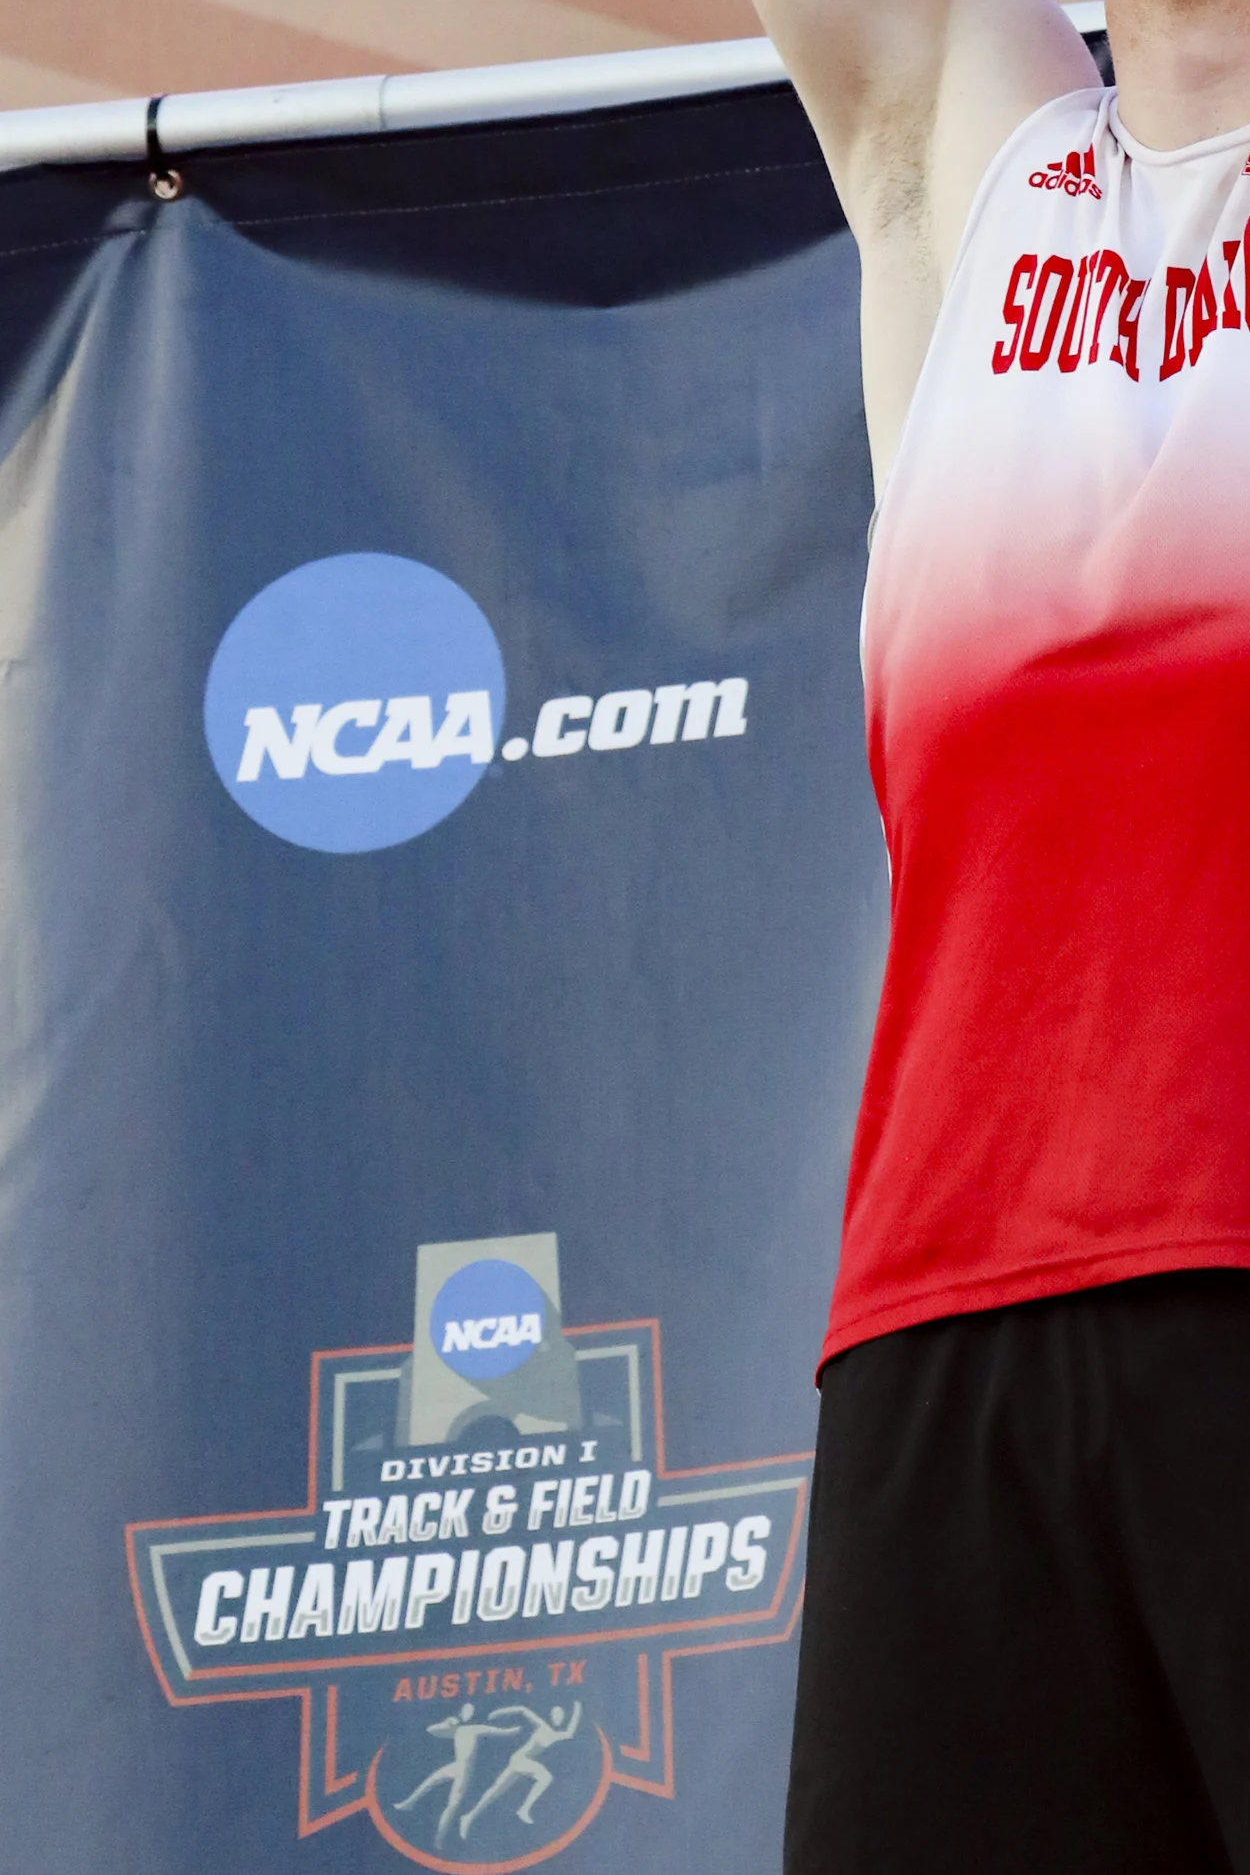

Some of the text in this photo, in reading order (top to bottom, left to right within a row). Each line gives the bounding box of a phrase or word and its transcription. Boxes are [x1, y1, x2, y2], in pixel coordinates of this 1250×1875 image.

[1028, 170, 1102, 200] adidas
[991, 249, 1150, 383] SOUTH
[236, 677, 748, 783] NCAA.com
[441, 1312, 543, 1353] NCAA
[380, 1439, 599, 1482] DIVISION I
[322, 1468, 653, 1550] TRACK & FIELD
[193, 1514, 772, 1647] CHAMPIONSHIPS
[392, 1659, 588, 1702] AUSTIN, TX
